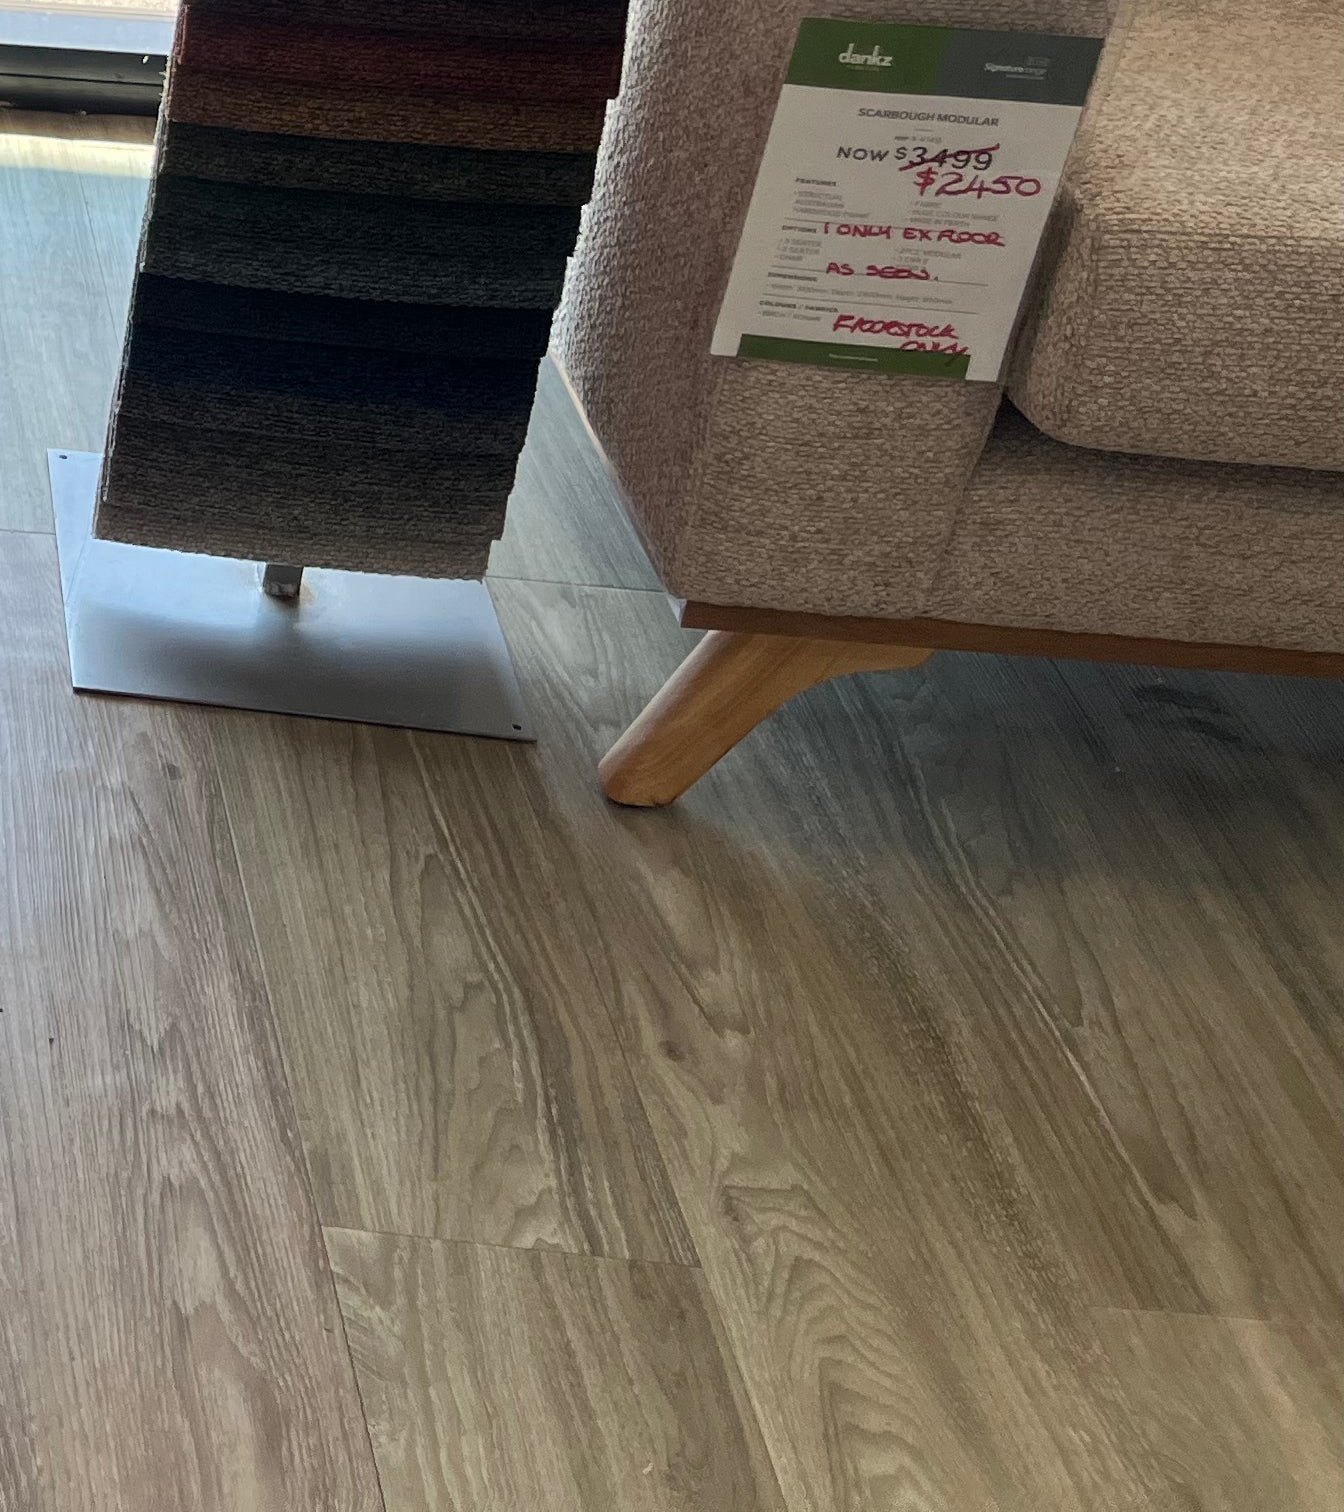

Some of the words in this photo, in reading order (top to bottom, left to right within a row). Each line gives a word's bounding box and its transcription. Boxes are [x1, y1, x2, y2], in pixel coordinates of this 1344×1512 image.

[838, 42, 893, 68] dankz
[936, 113, 1000, 127] MODULAR
[836, 146, 890, 162] NOW
[893, 144, 995, 172] $3499
[913, 166, 1043, 199] $2450
[836, 223, 893, 240] ONLY
[902, 227, 933, 242] EX
[825, 262, 855, 276] AS
